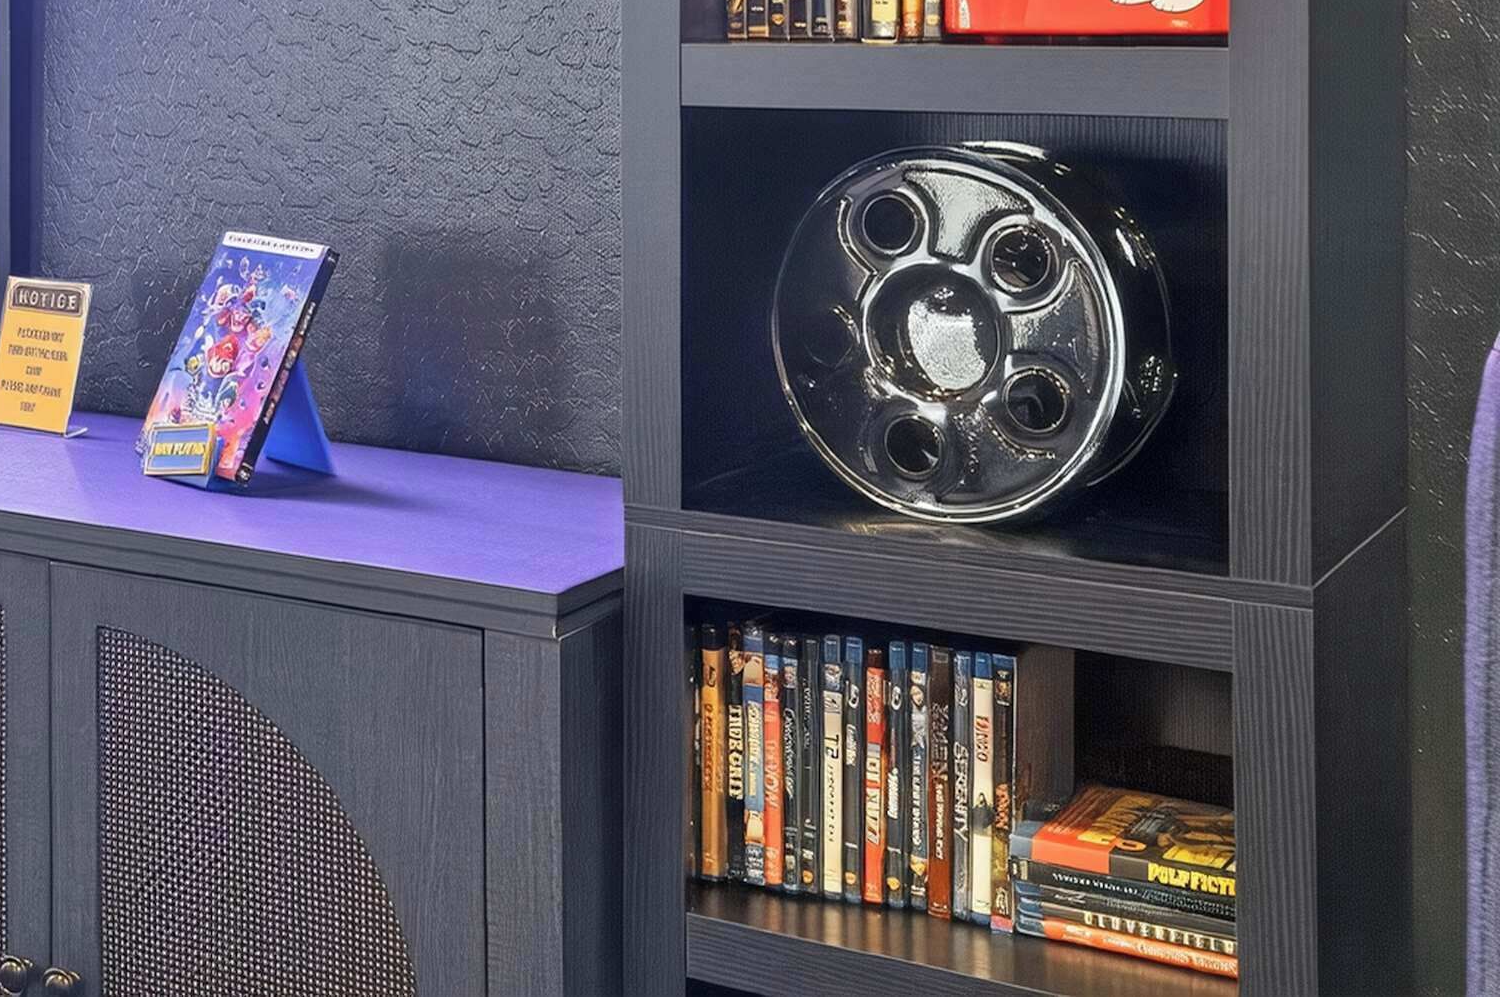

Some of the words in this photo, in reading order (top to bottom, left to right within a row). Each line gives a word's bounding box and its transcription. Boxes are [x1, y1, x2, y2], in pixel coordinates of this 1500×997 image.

[19, 289, 78, 310] NOTICE
[1147, 862, 1190, 888] PULP
[1190, 870, 1237, 897] FICTI
